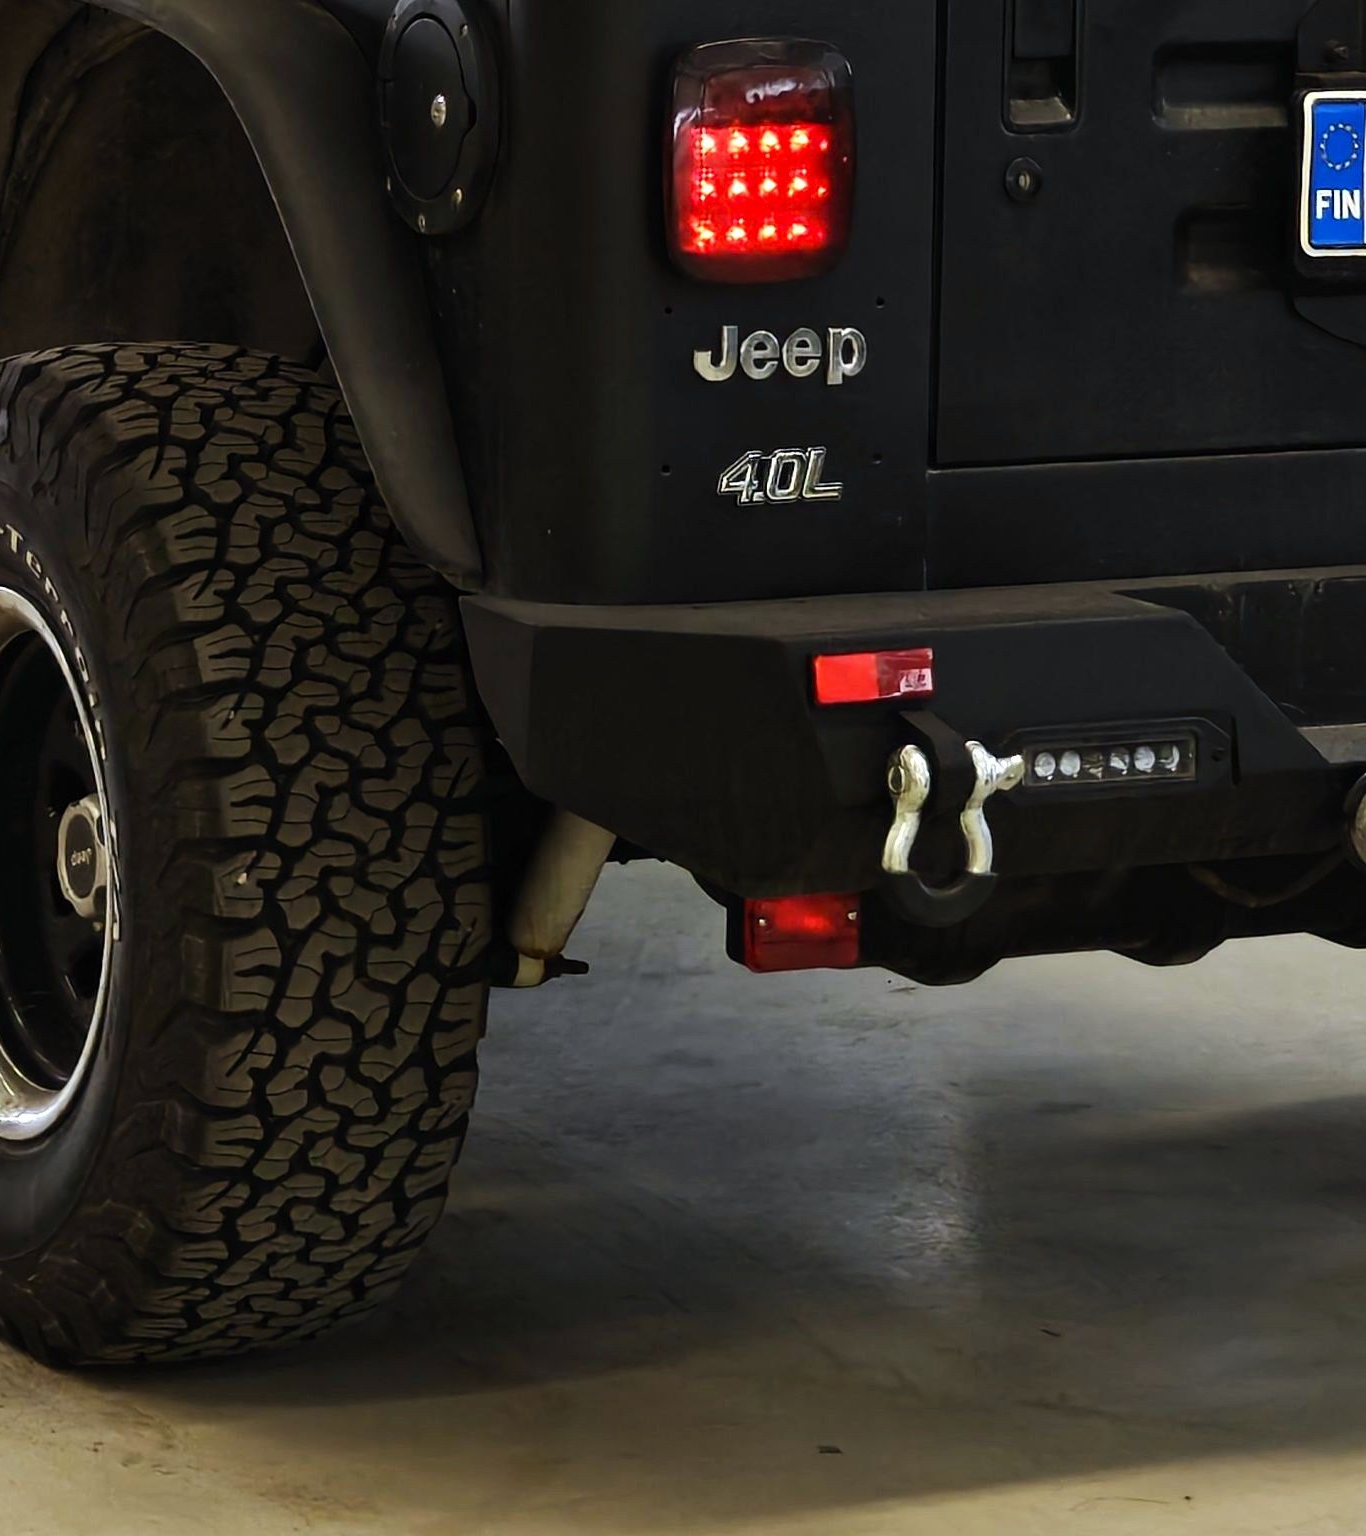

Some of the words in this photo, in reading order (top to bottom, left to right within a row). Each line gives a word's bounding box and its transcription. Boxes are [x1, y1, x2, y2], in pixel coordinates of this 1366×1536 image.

[1315, 189, 1362, 220] FIN
[693, 325, 867, 385] Jeep
[717, 446, 844, 507] 4.0L
